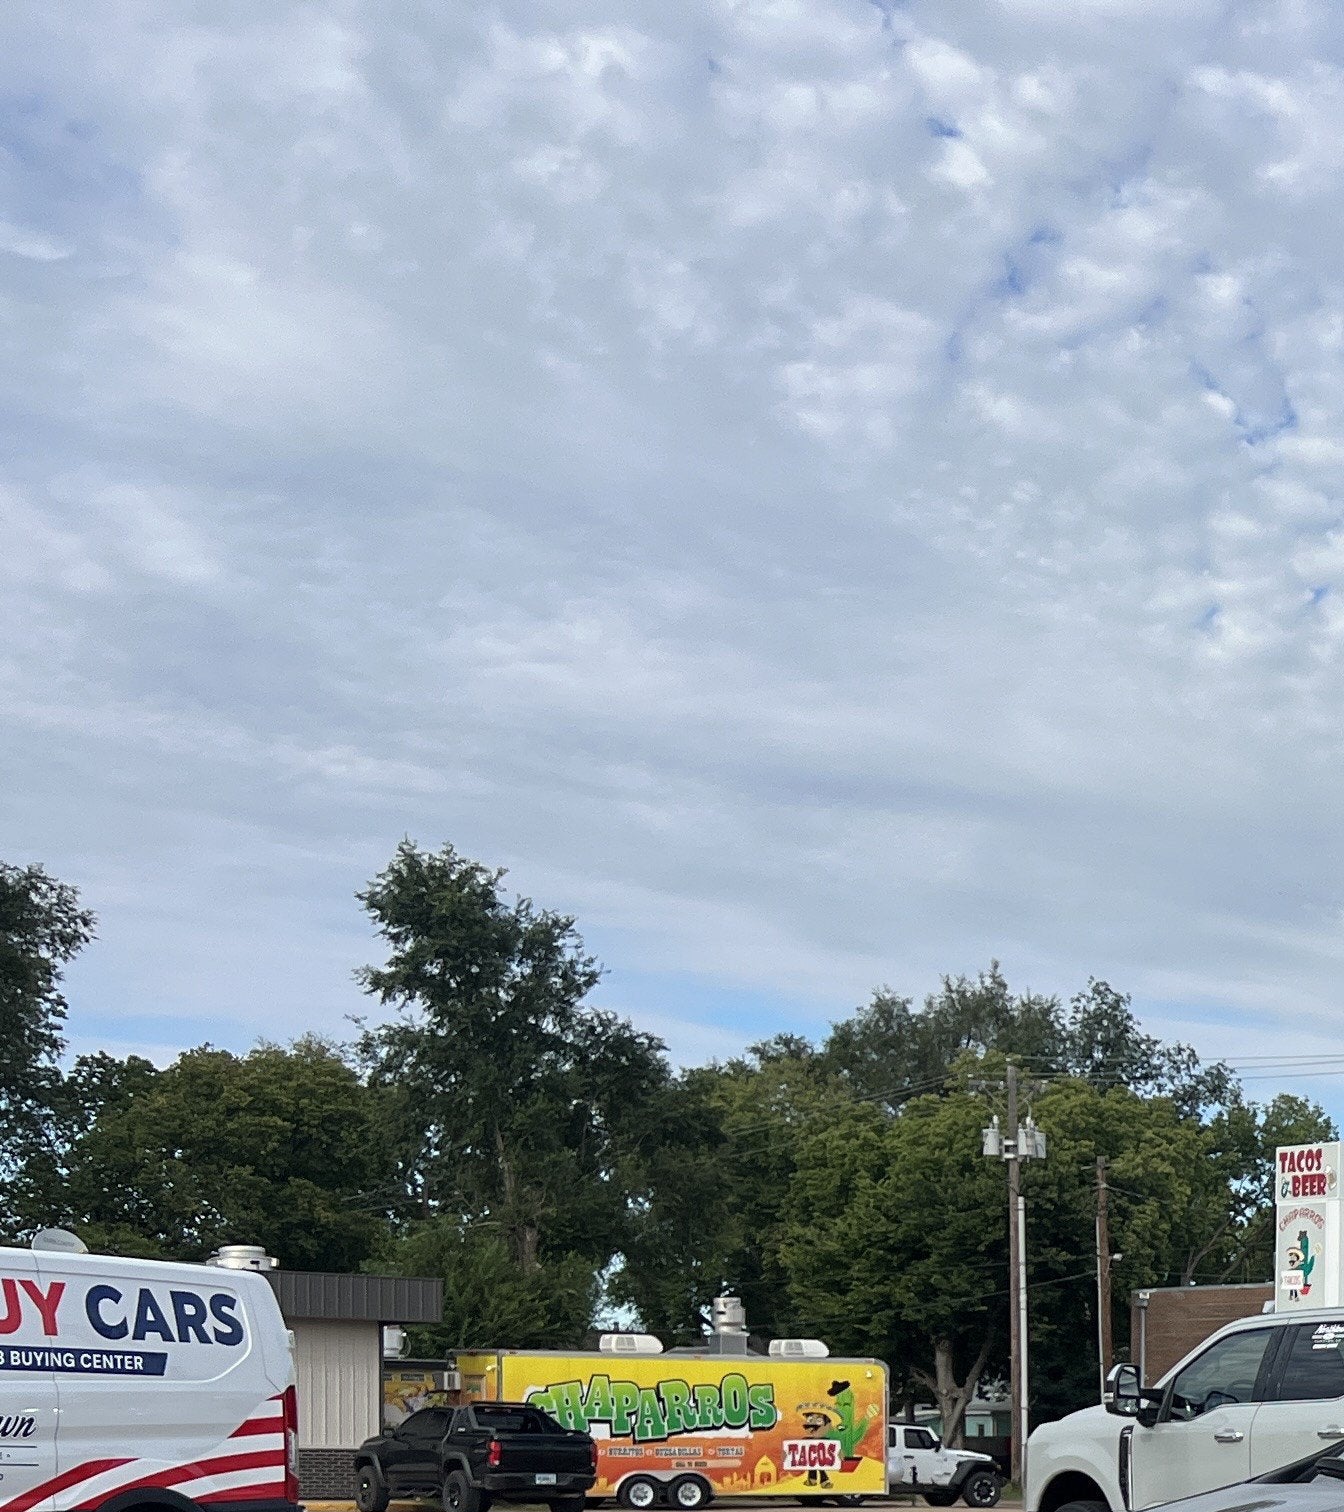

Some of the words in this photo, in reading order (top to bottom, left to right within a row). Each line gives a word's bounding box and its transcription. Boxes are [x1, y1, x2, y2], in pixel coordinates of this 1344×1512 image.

[1279, 1148, 1322, 1173] TACOS
[1292, 1173, 1326, 1197] BEER
[85, 1284, 244, 1346] CARS
[10, 1352, 75, 1368] BUYING
[80, 1353, 144, 1370] CENTER
[788, 1443, 836, 1467] TACOS
